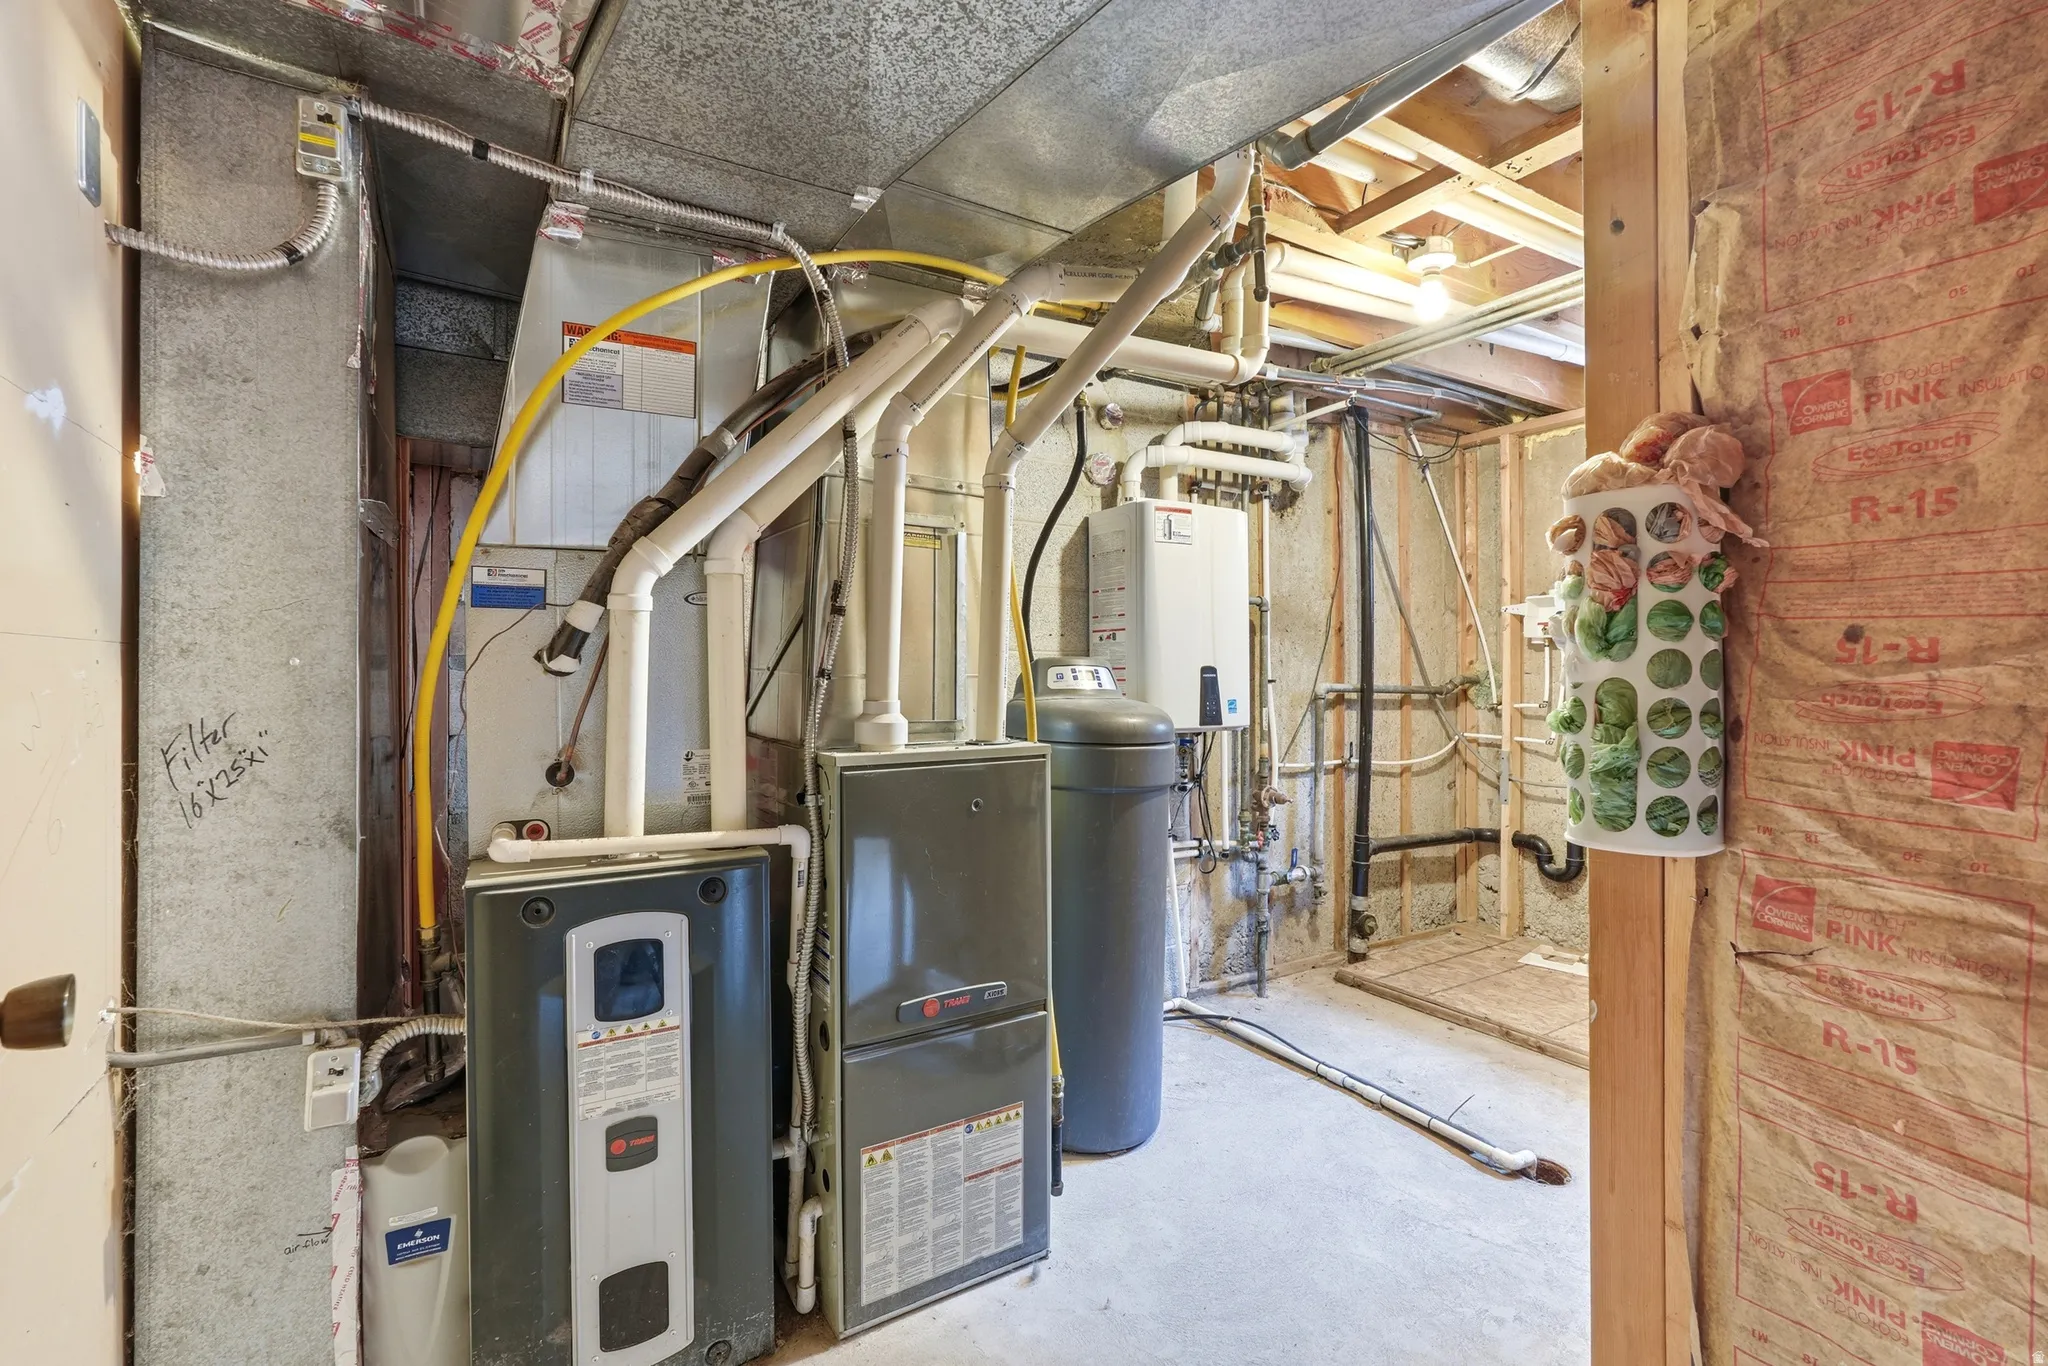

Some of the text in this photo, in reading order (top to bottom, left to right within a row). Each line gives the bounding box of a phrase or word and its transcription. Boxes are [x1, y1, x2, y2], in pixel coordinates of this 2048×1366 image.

[1854, 59, 1965, 132] R-15
[1979, 166, 2045, 192] OWENS
[1774, 183, 1957, 249] PINK INSULATION
[1949, 284, 1969, 299] 30
[1836, 313, 1854, 327] 18
[1863, 365, 2048, 413] PINK INSULATIO
[1794, 410, 1849, 427] CORNING
[1802, 399, 1848, 415] OWENS
[1848, 431, 1972, 462] EcoTouch
[1851, 486, 1960, 524] R-15
[1833, 635, 1940, 665] R-15
[1821, 692, 1943, 714] EcoTouch
[161, 712, 237, 791] Filter
[1754, 732, 1916, 768] PINK INSULATION
[1936, 750, 2013, 768] CORNING
[1936, 760, 1997, 777] OWENS
[1805, 832, 1820, 845] 18
[1757, 912, 1809, 935] CORNING
[1765, 904, 1810, 924] OWENS
[1826, 920, 2012, 982] PINK INSULATION
[943, 994, 971, 1008] TRANE
[1815, 967, 1925, 1013] EcoTouch
[1822, 1020, 1918, 1076] R-15
[629, 1134, 656, 1147] TRANE
[1813, 1160, 1918, 1224] R-15
[284, 1237, 329, 1255] air flow
[397, 1234, 440, 1250] EMERSON
[1808, 1217, 1925, 1284] EcoTouch
[1748, 1230, 1906, 1330] PINK INSULATION
[1927, 1331, 1988, 1366] OWENS
